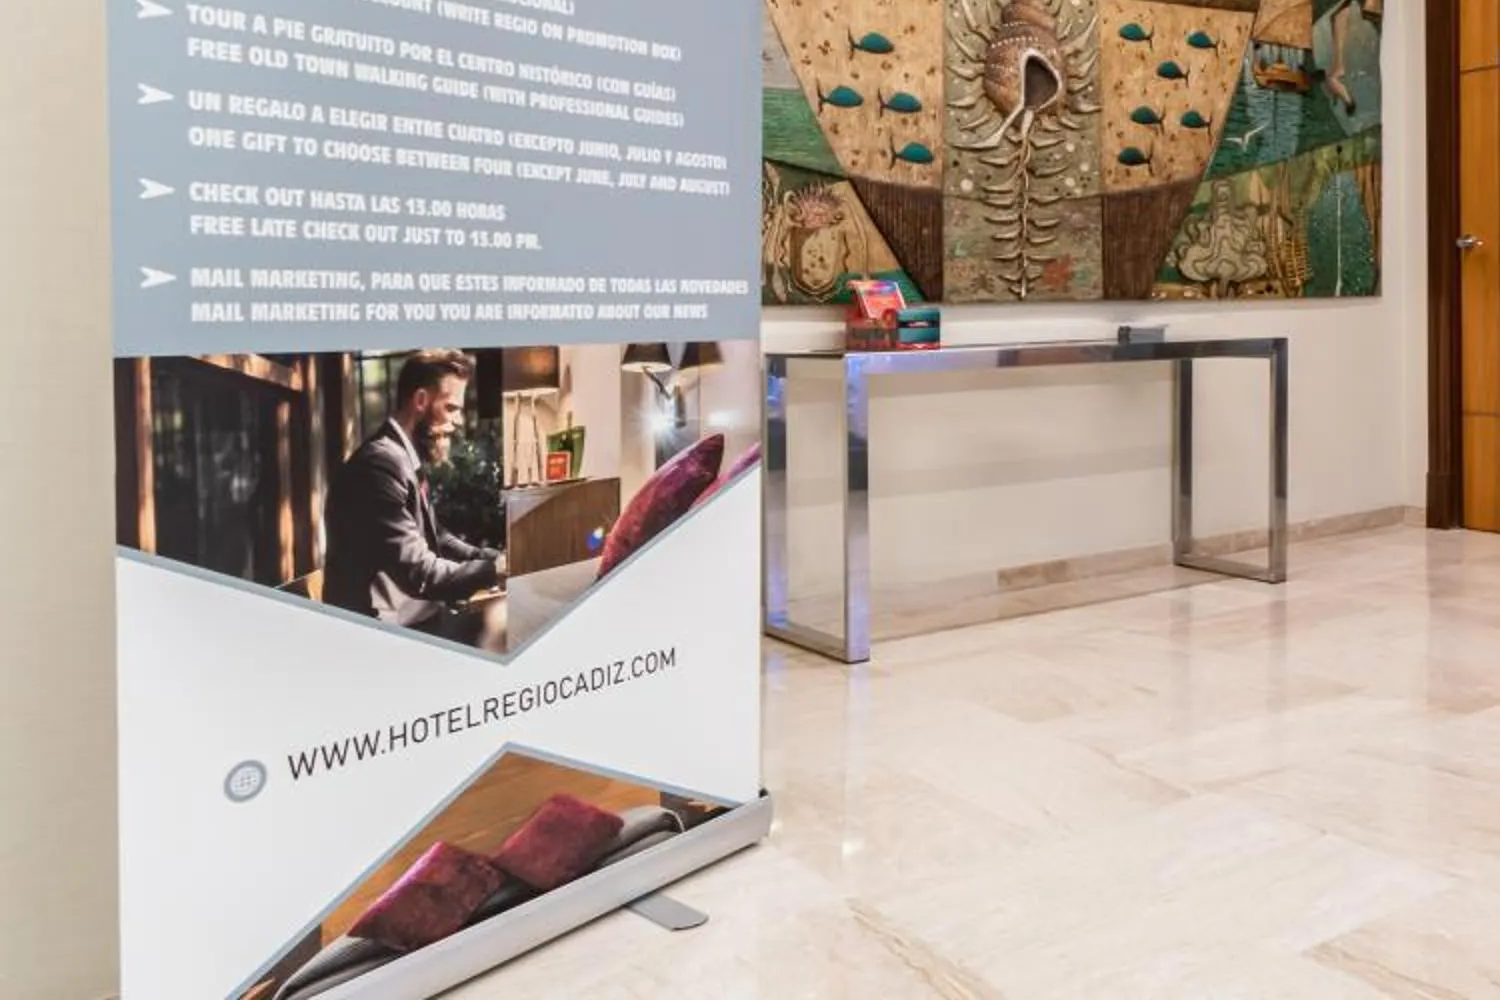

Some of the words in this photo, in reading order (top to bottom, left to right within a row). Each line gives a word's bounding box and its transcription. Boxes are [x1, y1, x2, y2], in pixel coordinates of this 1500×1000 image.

[185, 3, 246, 31] TOUR
[251, 14, 268, 35] A
[272, 16, 305, 41] PIE
[310, 24, 396, 57] GRATUITO
[400, 40, 433, 65] POR
[437, 48, 454, 68] EL
[458, 52, 515, 77] CENTRO
[518, 63, 593, 91] HISTÓRICO
[596, 76, 630, 97] (CON
[437, 2, 491, 26] (WRITE
[493, 11, 538, 35] REGIO
[541, 21, 563, 42] ON
[567, 25, 648, 56] PROMOTION
[651, 42, 681, 62] BOX)
[187, 36, 243, 64] FREE
[248, 45, 288, 70] OLD
[293, 51, 349, 80] TOWN
[353, 61, 429, 93] WALKING
[432, 77, 479, 99] GUIDE
[483, 85, 526, 108] (WITH
[529, 91, 630, 122] PROFESSIONAL
[633, 105, 685, 129] GUIDES)
[188, 89, 222, 112] UN
[228, 91, 306, 121] REGALO
[310, 104, 326, 124] A
[329, 106, 389, 131] ELEGIR
[393, 115, 444, 139] ENTRE
[448, 122, 504, 147] CUATRO
[508, 128, 574, 156] (EXCEPTO
[626, 146, 661, 165] JULIO
[665, 150, 672, 166] Y
[675, 151, 727, 171] AGOSTO)
[188, 125, 236, 149] ONE
[241, 131, 288, 155] GIFT
[292, 136, 318, 157] TO
[323, 140, 392, 165] CHOOSE
[396, 147, 470, 173] BETWEEN
[473, 156, 512, 178] FOUR
[516, 161, 571, 183] (EXCEPT
[618, 172, 646, 190] JULY
[649, 174, 677, 192] AND
[679, 177, 730, 196] AUGUST)
[188, 181, 259, 206] CHECK
[264, 186, 305, 207] OUT
[310, 189, 366, 213] HASTA
[370, 195, 400, 215] LAS
[405, 198, 452, 219] 13.00
[456, 201, 506, 222] HORAS
[190, 215, 245, 236] FREE
[250, 217, 297, 239] LATE
[302, 220, 360, 242] CHECK
[364, 223, 400, 243] OUT
[402, 225, 441, 246] JUST
[445, 228, 464, 247] TO
[469, 230, 511, 250] 15.00
[190, 267, 244, 288] MAIL
[250, 268, 366, 292] MARKETING,
[370, 271, 414, 291] PARA
[419, 272, 451, 292] QUE
[503, 275, 584, 293] INFORMADO
[588, 277, 606, 294] DE
[610, 278, 651, 294] TODAS
[655, 279, 677, 294] LAS
[680, 280, 749, 296] NOVEDADES
[191, 302, 244, 322] MAIL
[251, 302, 361, 322] MARKETING
[365, 303, 399, 321] FOR
[403, 303, 435, 321] YOU
[441, 303, 471, 321] YOU
[475, 303, 503, 320] ARE
[597, 304, 640, 319] ABOUT
[643, 304, 667, 319] OUR
[672, 304, 708, 319] NEWS
[287, 647, 676, 780] WWW.HOTELREGIOCADIZ.COM
